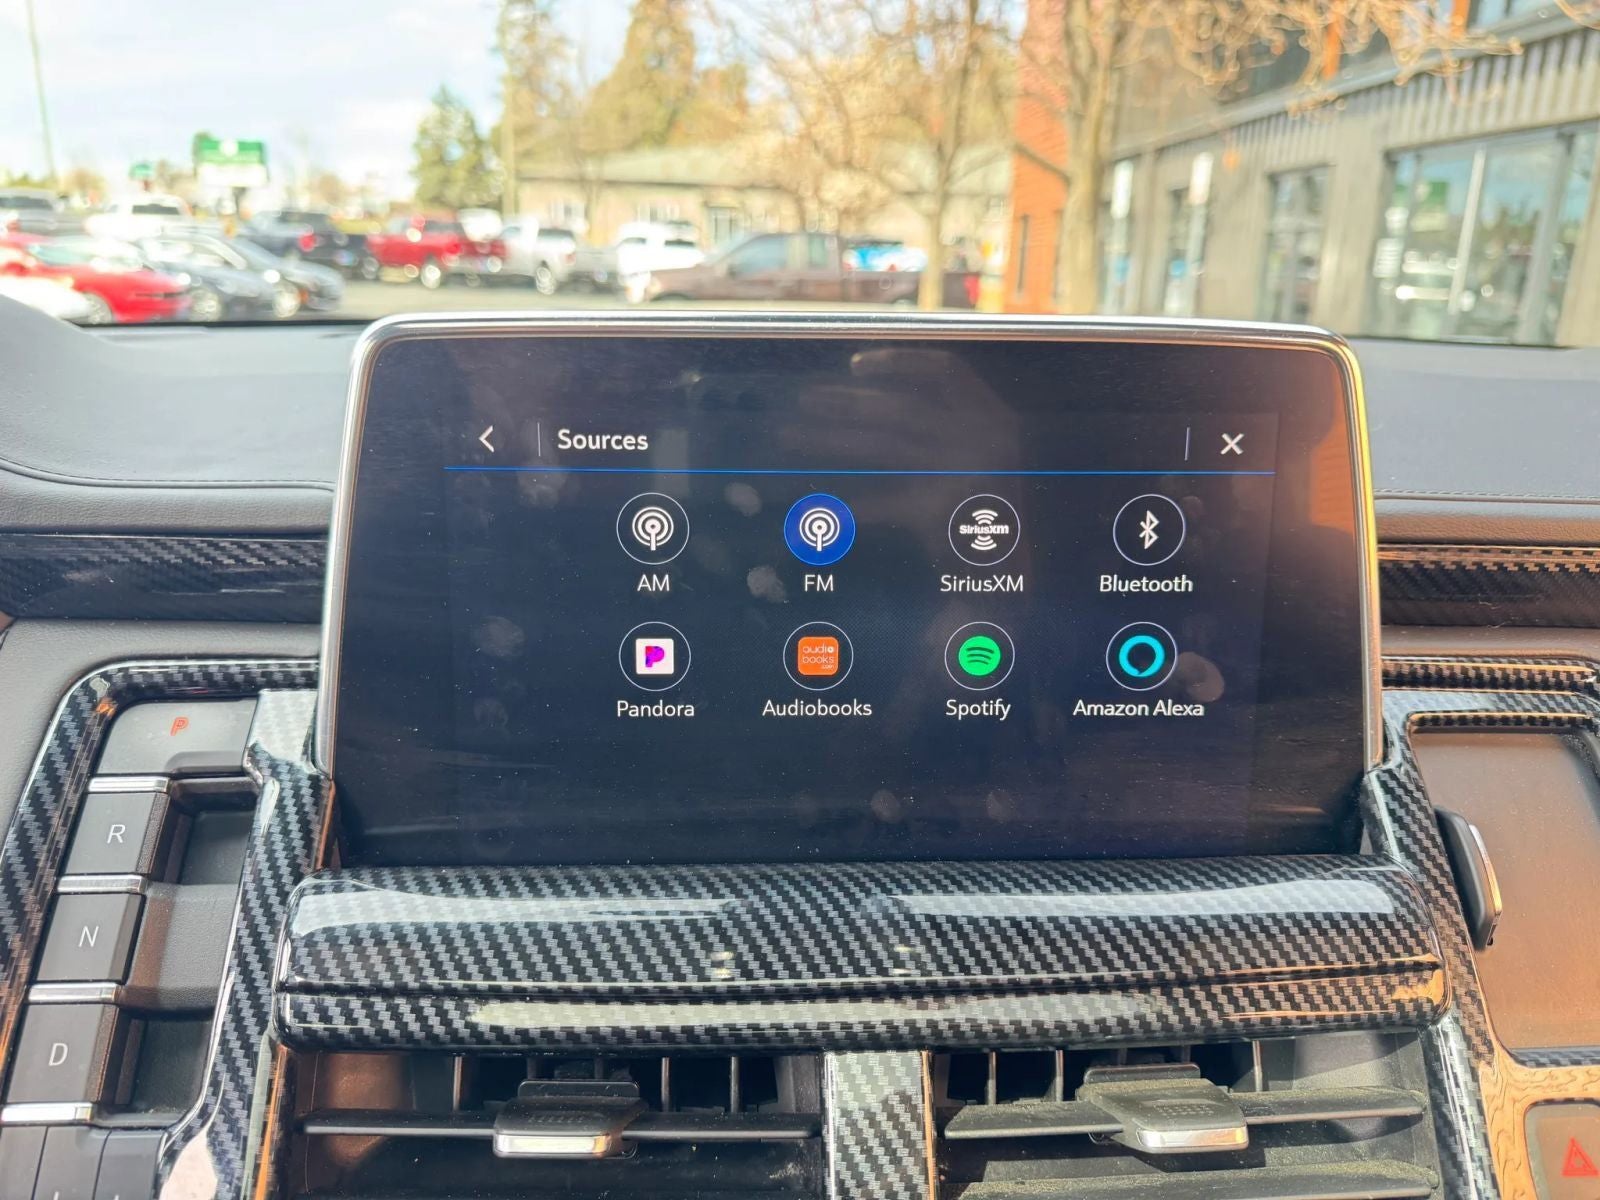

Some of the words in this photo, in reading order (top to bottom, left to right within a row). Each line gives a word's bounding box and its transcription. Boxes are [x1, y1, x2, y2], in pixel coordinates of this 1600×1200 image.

[557, 428, 649, 451] Sources
[637, 574, 670, 592] AM
[804, 575, 834, 592] FM
[940, 575, 1024, 592] SiriusXM
[1099, 574, 1194, 592] Bluetooth
[645, 645, 665, 668] P
[803, 643, 834, 653] audio
[803, 654, 834, 664] books
[617, 699, 695, 718] Pandora
[763, 699, 873, 717] Audiobooks
[945, 699, 1012, 721] Spotify
[1073, 699, 1150, 716] Amazon
[1152, 699, 1205, 717] Alexa
[170, 716, 189, 737] P
[106, 824, 126, 844] R
[78, 925, 100, 948] N
[48, 1042, 69, 1067] D
